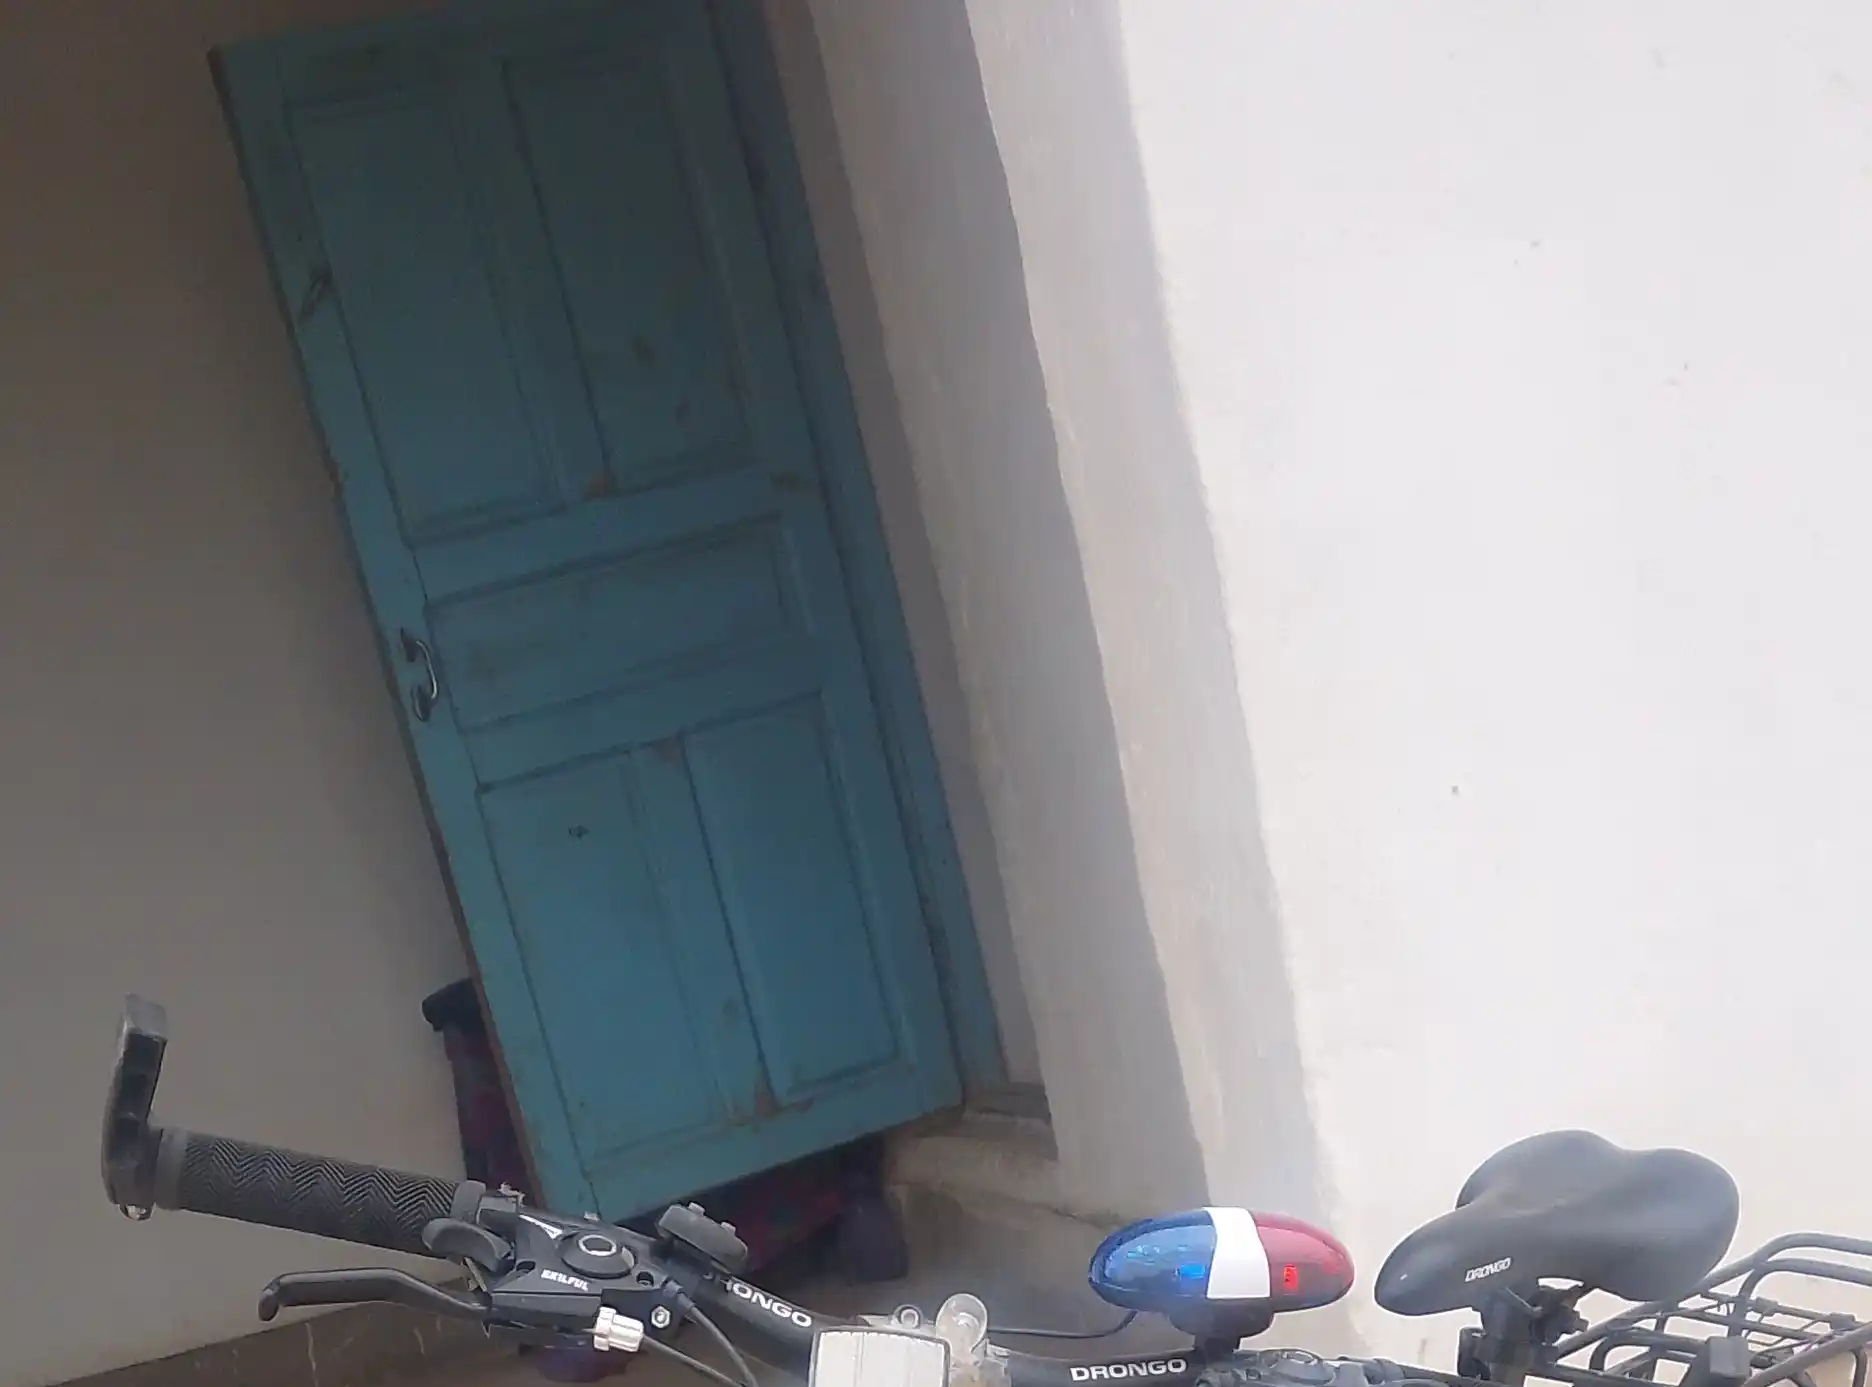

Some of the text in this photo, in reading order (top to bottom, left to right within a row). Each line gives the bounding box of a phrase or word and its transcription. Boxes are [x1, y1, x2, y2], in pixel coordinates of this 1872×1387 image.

[1464, 1257, 1512, 1283] DRONGO
[725, 1279, 813, 1328] ONGO
[1069, 1359, 1187, 1381] DRONGO
